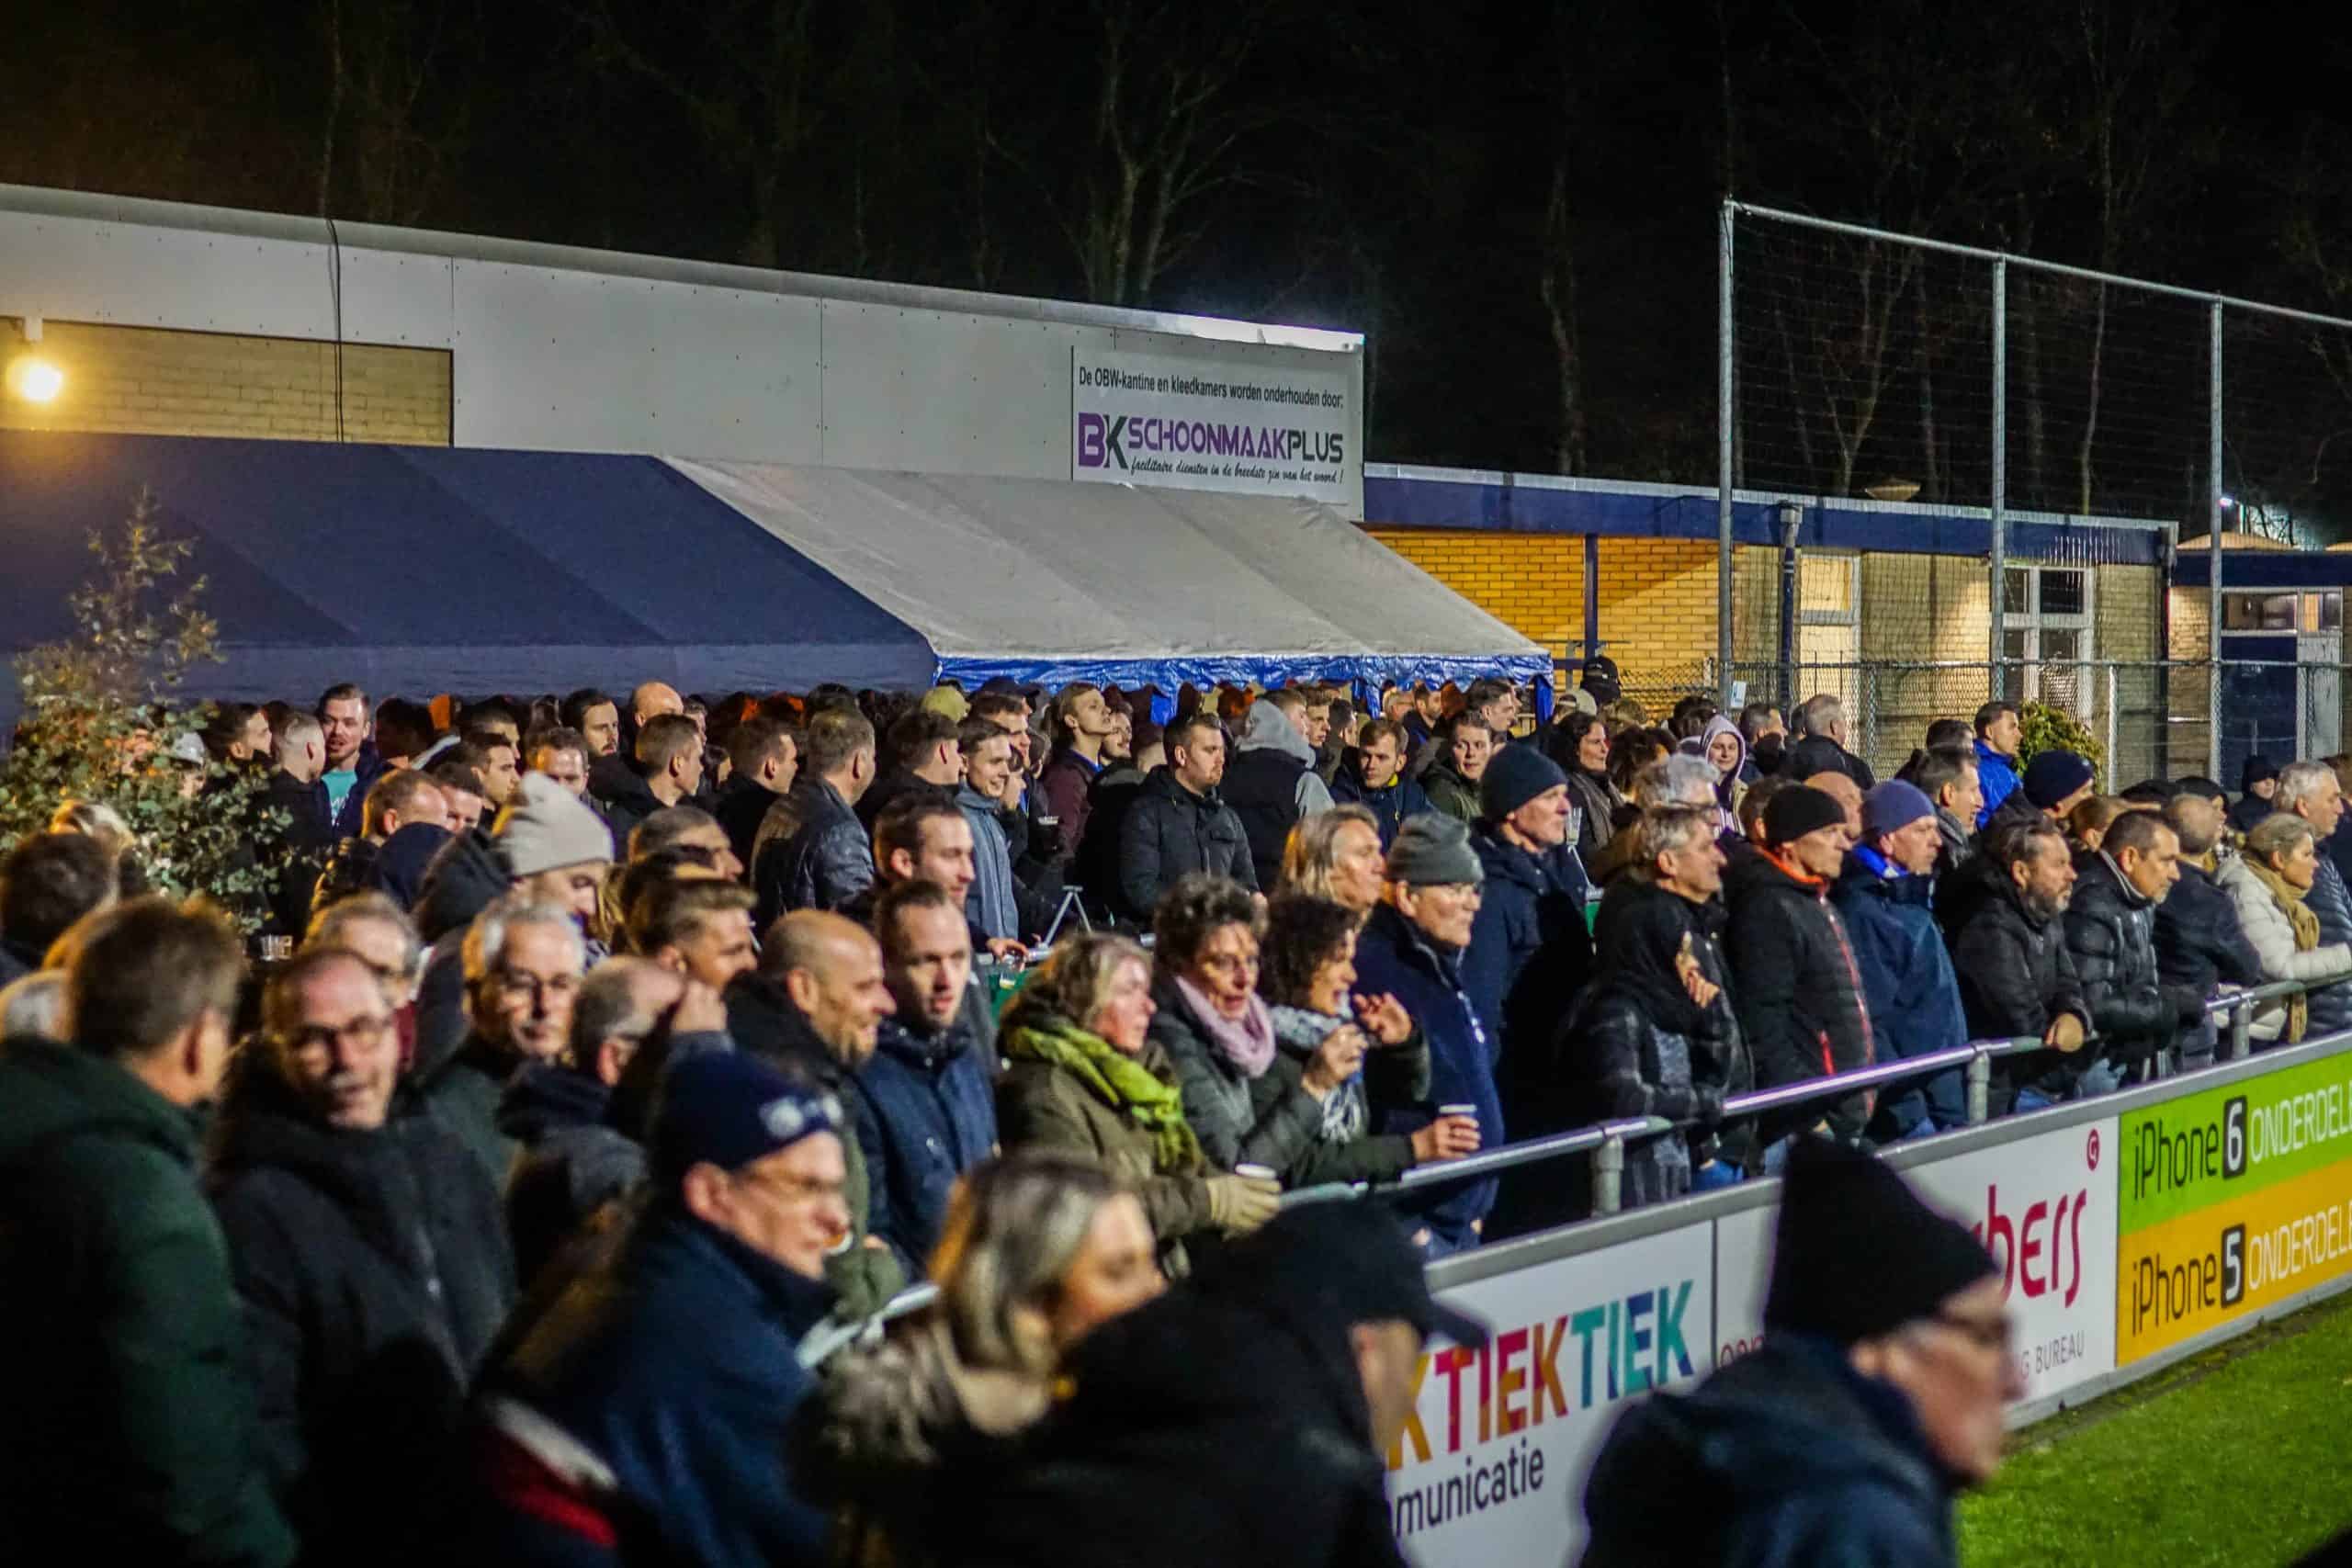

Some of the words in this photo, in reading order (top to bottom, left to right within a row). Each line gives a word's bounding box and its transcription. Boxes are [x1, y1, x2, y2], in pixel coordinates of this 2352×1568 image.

[1079, 367, 1092, 385] De
[1094, 367, 1155, 392] OBW-kantine
[1157, 378, 1169, 393] en
[1171, 375, 1227, 398] kleedkamers
[1229, 382, 1261, 400] worden
[1263, 385, 1320, 405] onderhouden
[1321, 389, 1343, 409] door:
[1131, 457, 1173, 476] facilitaire
[1176, 459, 1208, 476] diensten
[1211, 464, 1219, 476] in
[1222, 463, 1231, 477] de
[1235, 462, 1265, 479] breedste
[1268, 469, 1280, 484] zin
[1283, 470, 1297, 480] van
[1299, 467, 1312, 482] het
[2134, 1118, 2220, 1201] iPhone
[2226, 1100, 2245, 1174] 6
[2132, 1252, 2217, 1337] iPhone
[2224, 1229, 2243, 1303] 5
[2036, 1329, 2086, 1374] BUREAU
[1396, 1436, 1544, 1538] municatie
